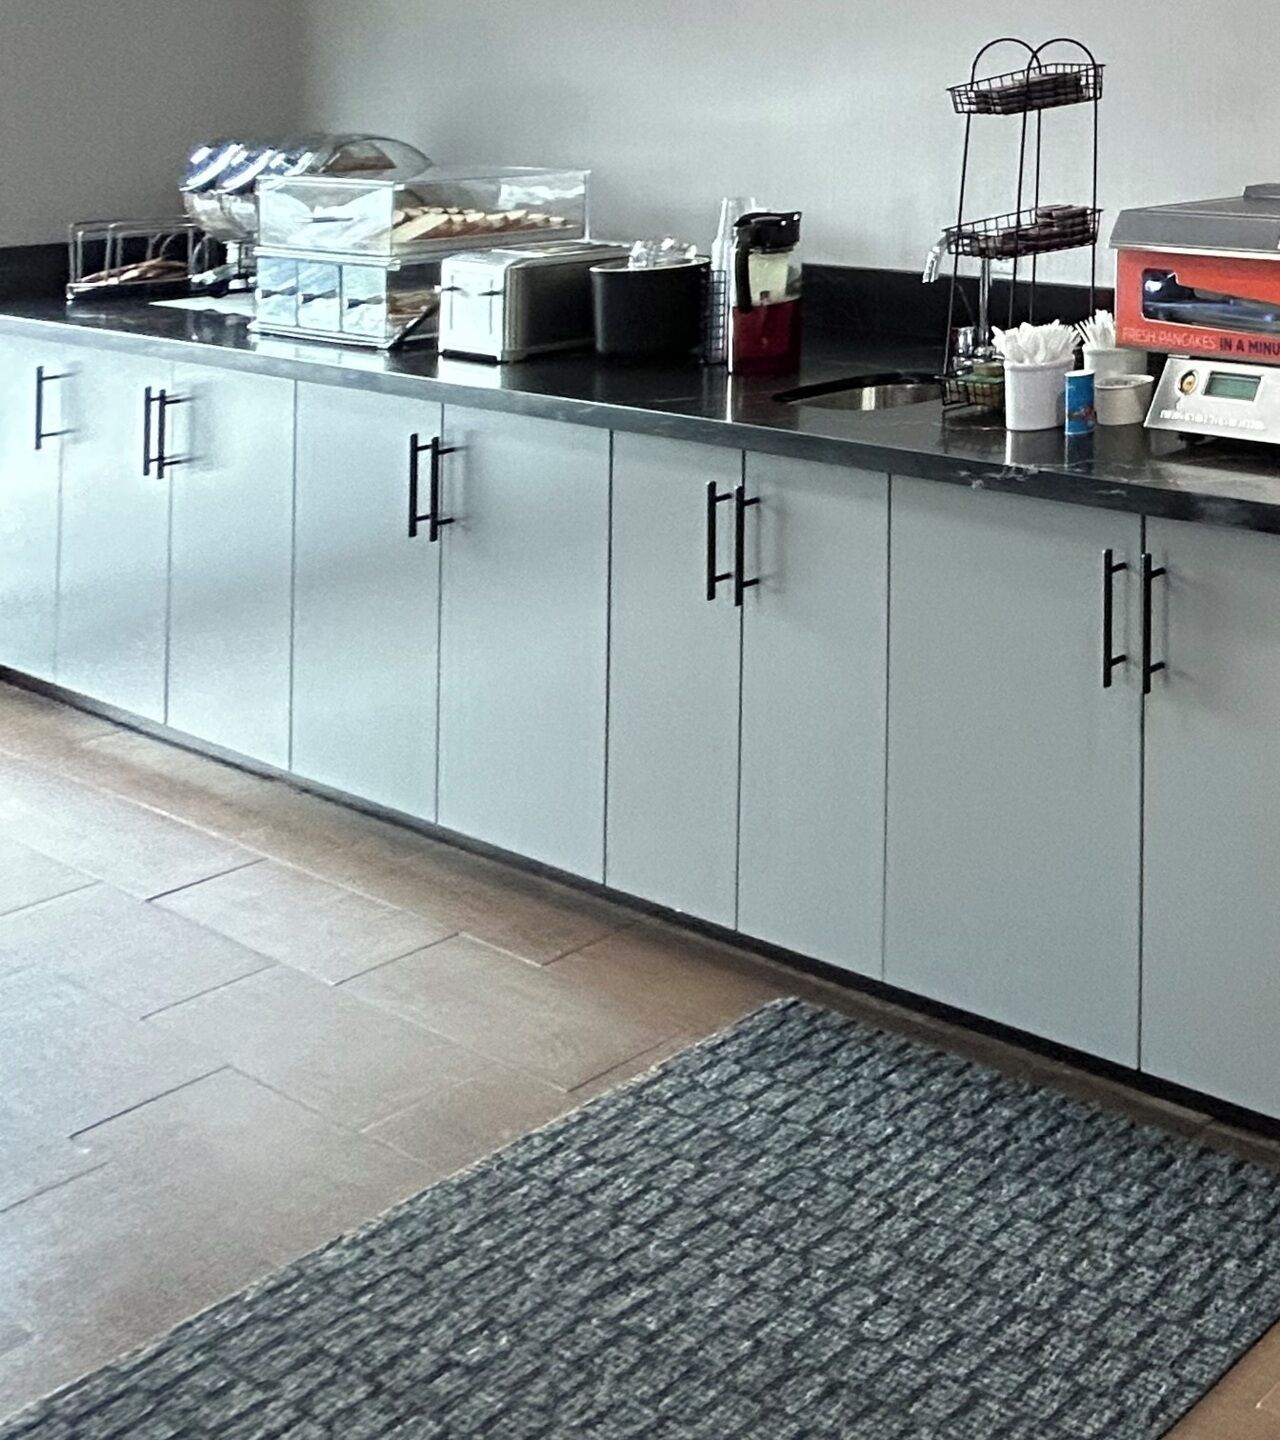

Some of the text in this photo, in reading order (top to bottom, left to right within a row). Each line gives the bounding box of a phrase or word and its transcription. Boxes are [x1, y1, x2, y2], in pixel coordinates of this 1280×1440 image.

[1158, 330, 1217, 350] PANCAKES
[1220, 337, 1233, 352] IN
[1236, 339, 1245, 353] A
